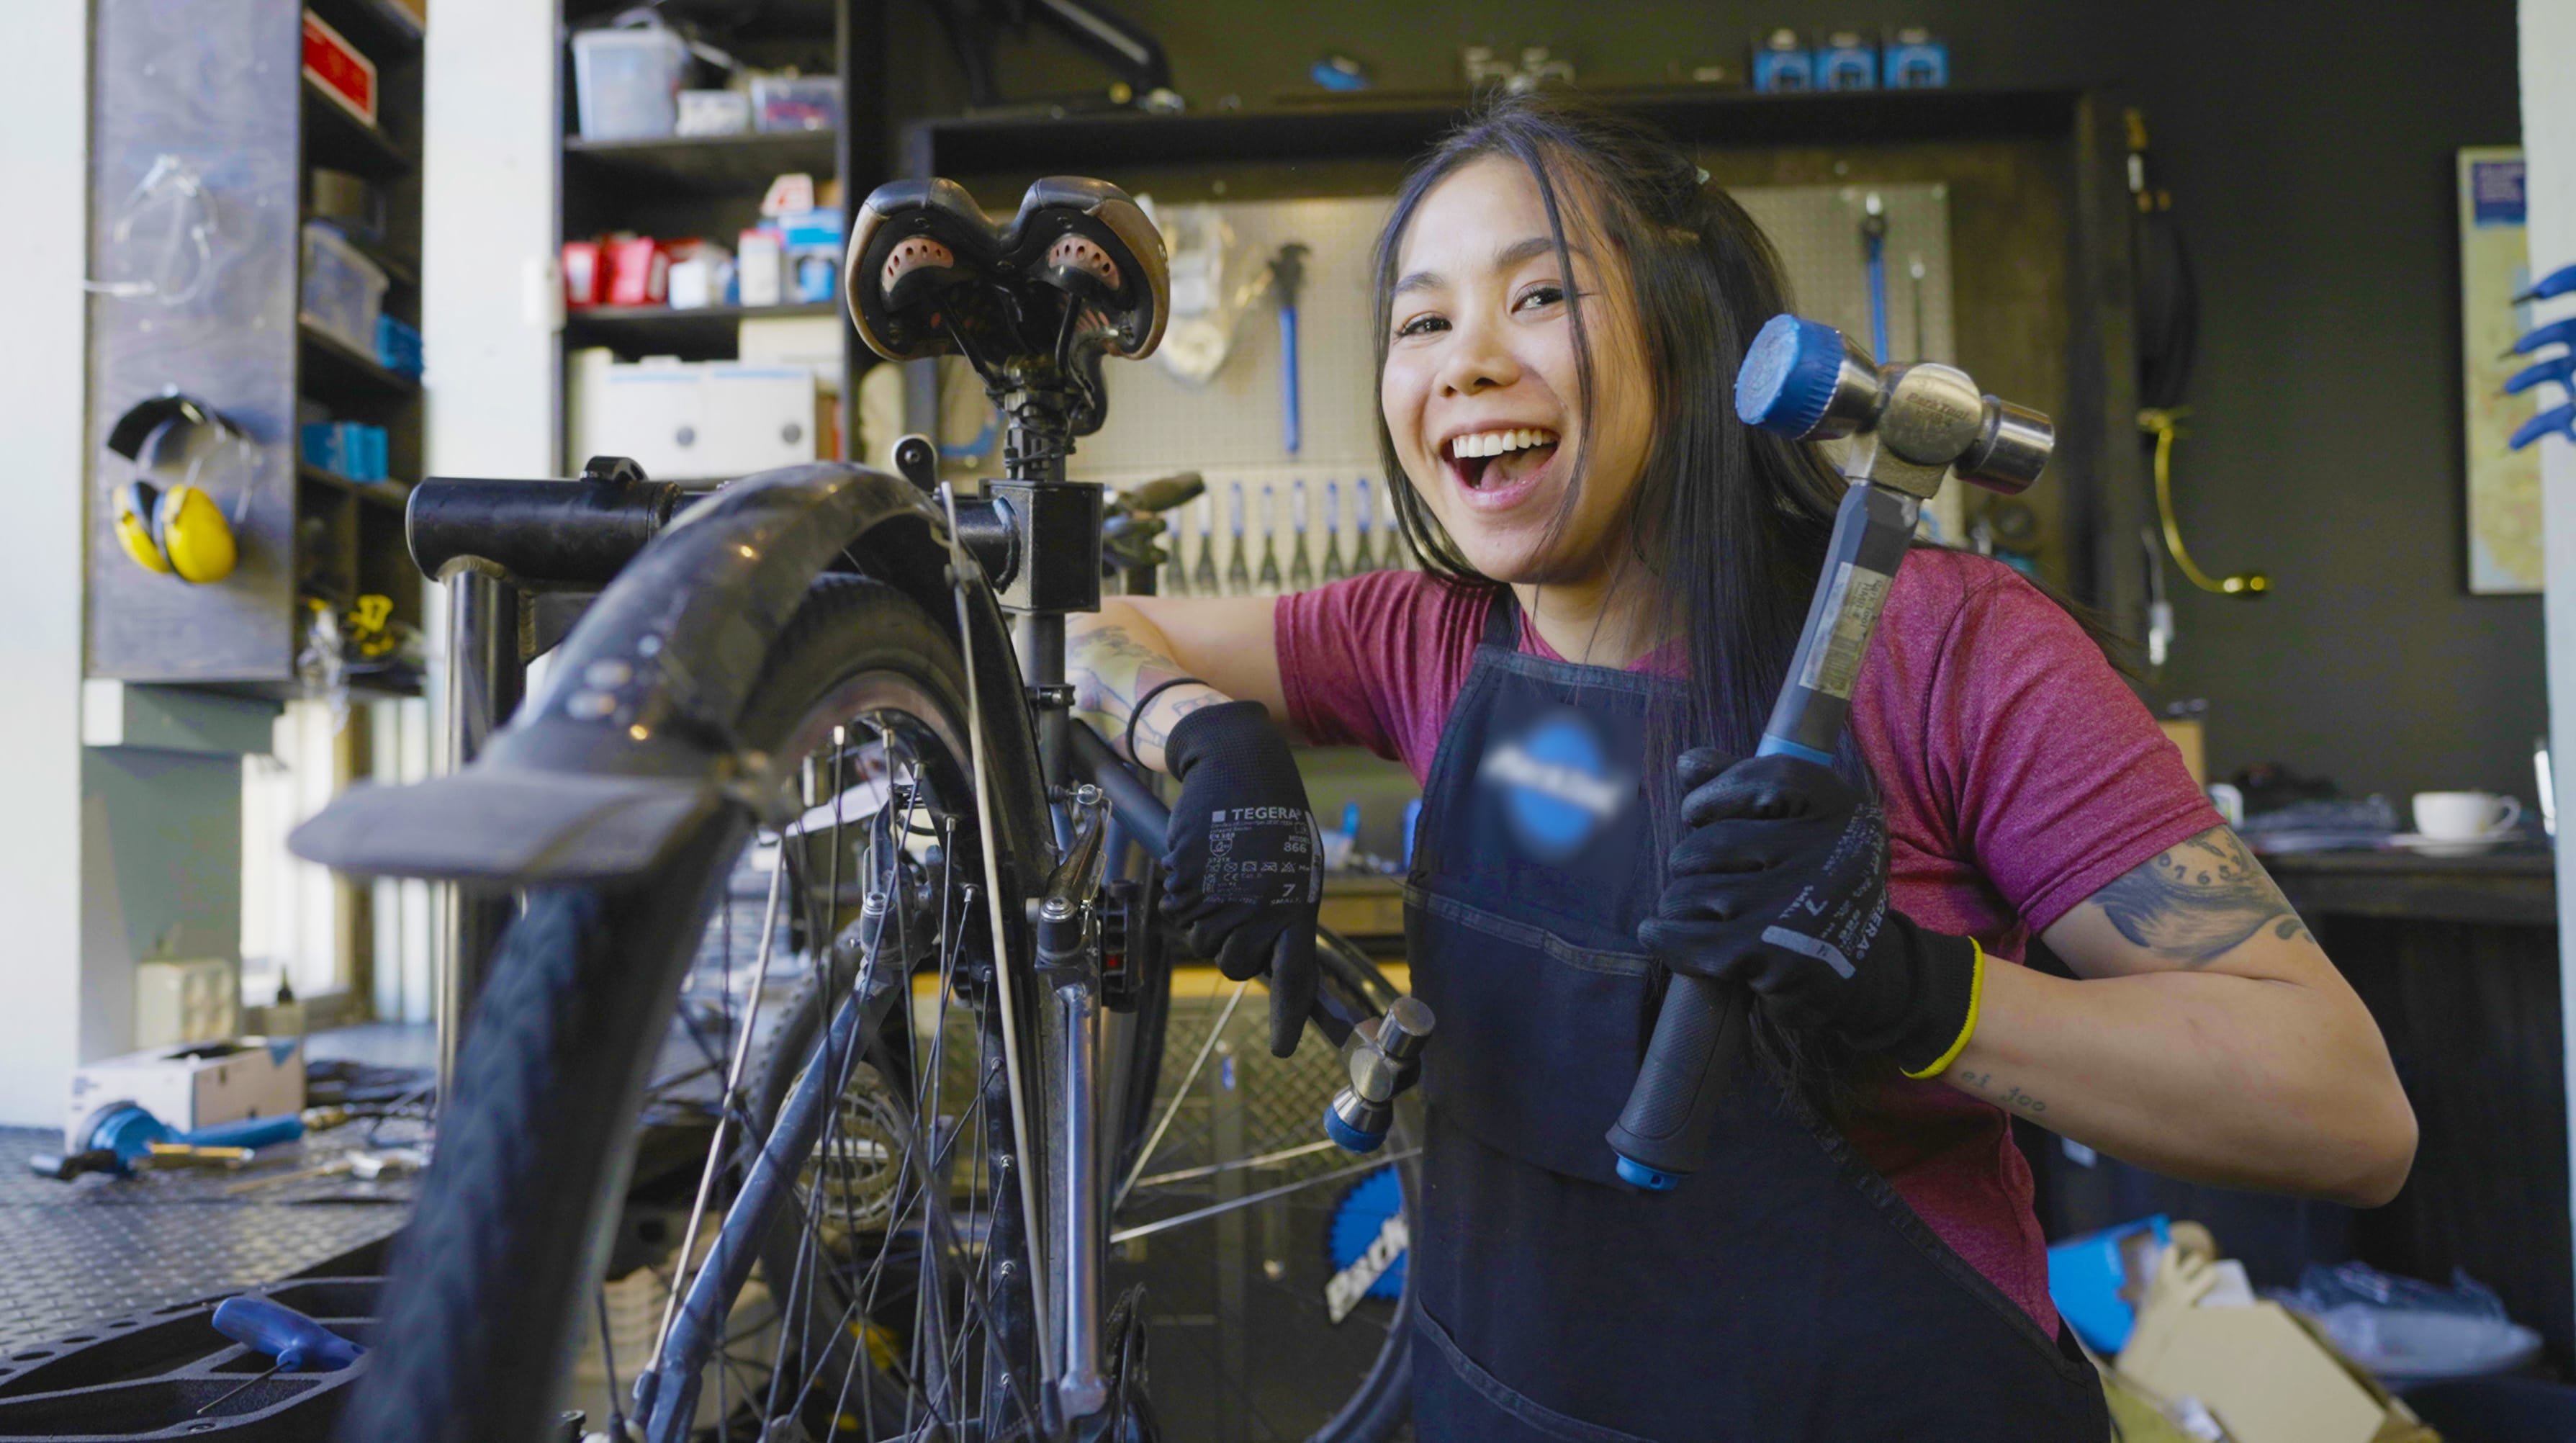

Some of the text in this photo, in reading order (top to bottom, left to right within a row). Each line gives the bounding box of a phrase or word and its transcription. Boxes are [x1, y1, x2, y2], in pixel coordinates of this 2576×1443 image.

[1860, 608, 1873, 627] Tool
[1284, 841, 1307, 853] 866
[2174, 866, 2187, 879] 7
[2197, 870, 2211, 885] 6
[1282, 884, 1296, 897] 7
[1805, 900, 1829, 916] 7
